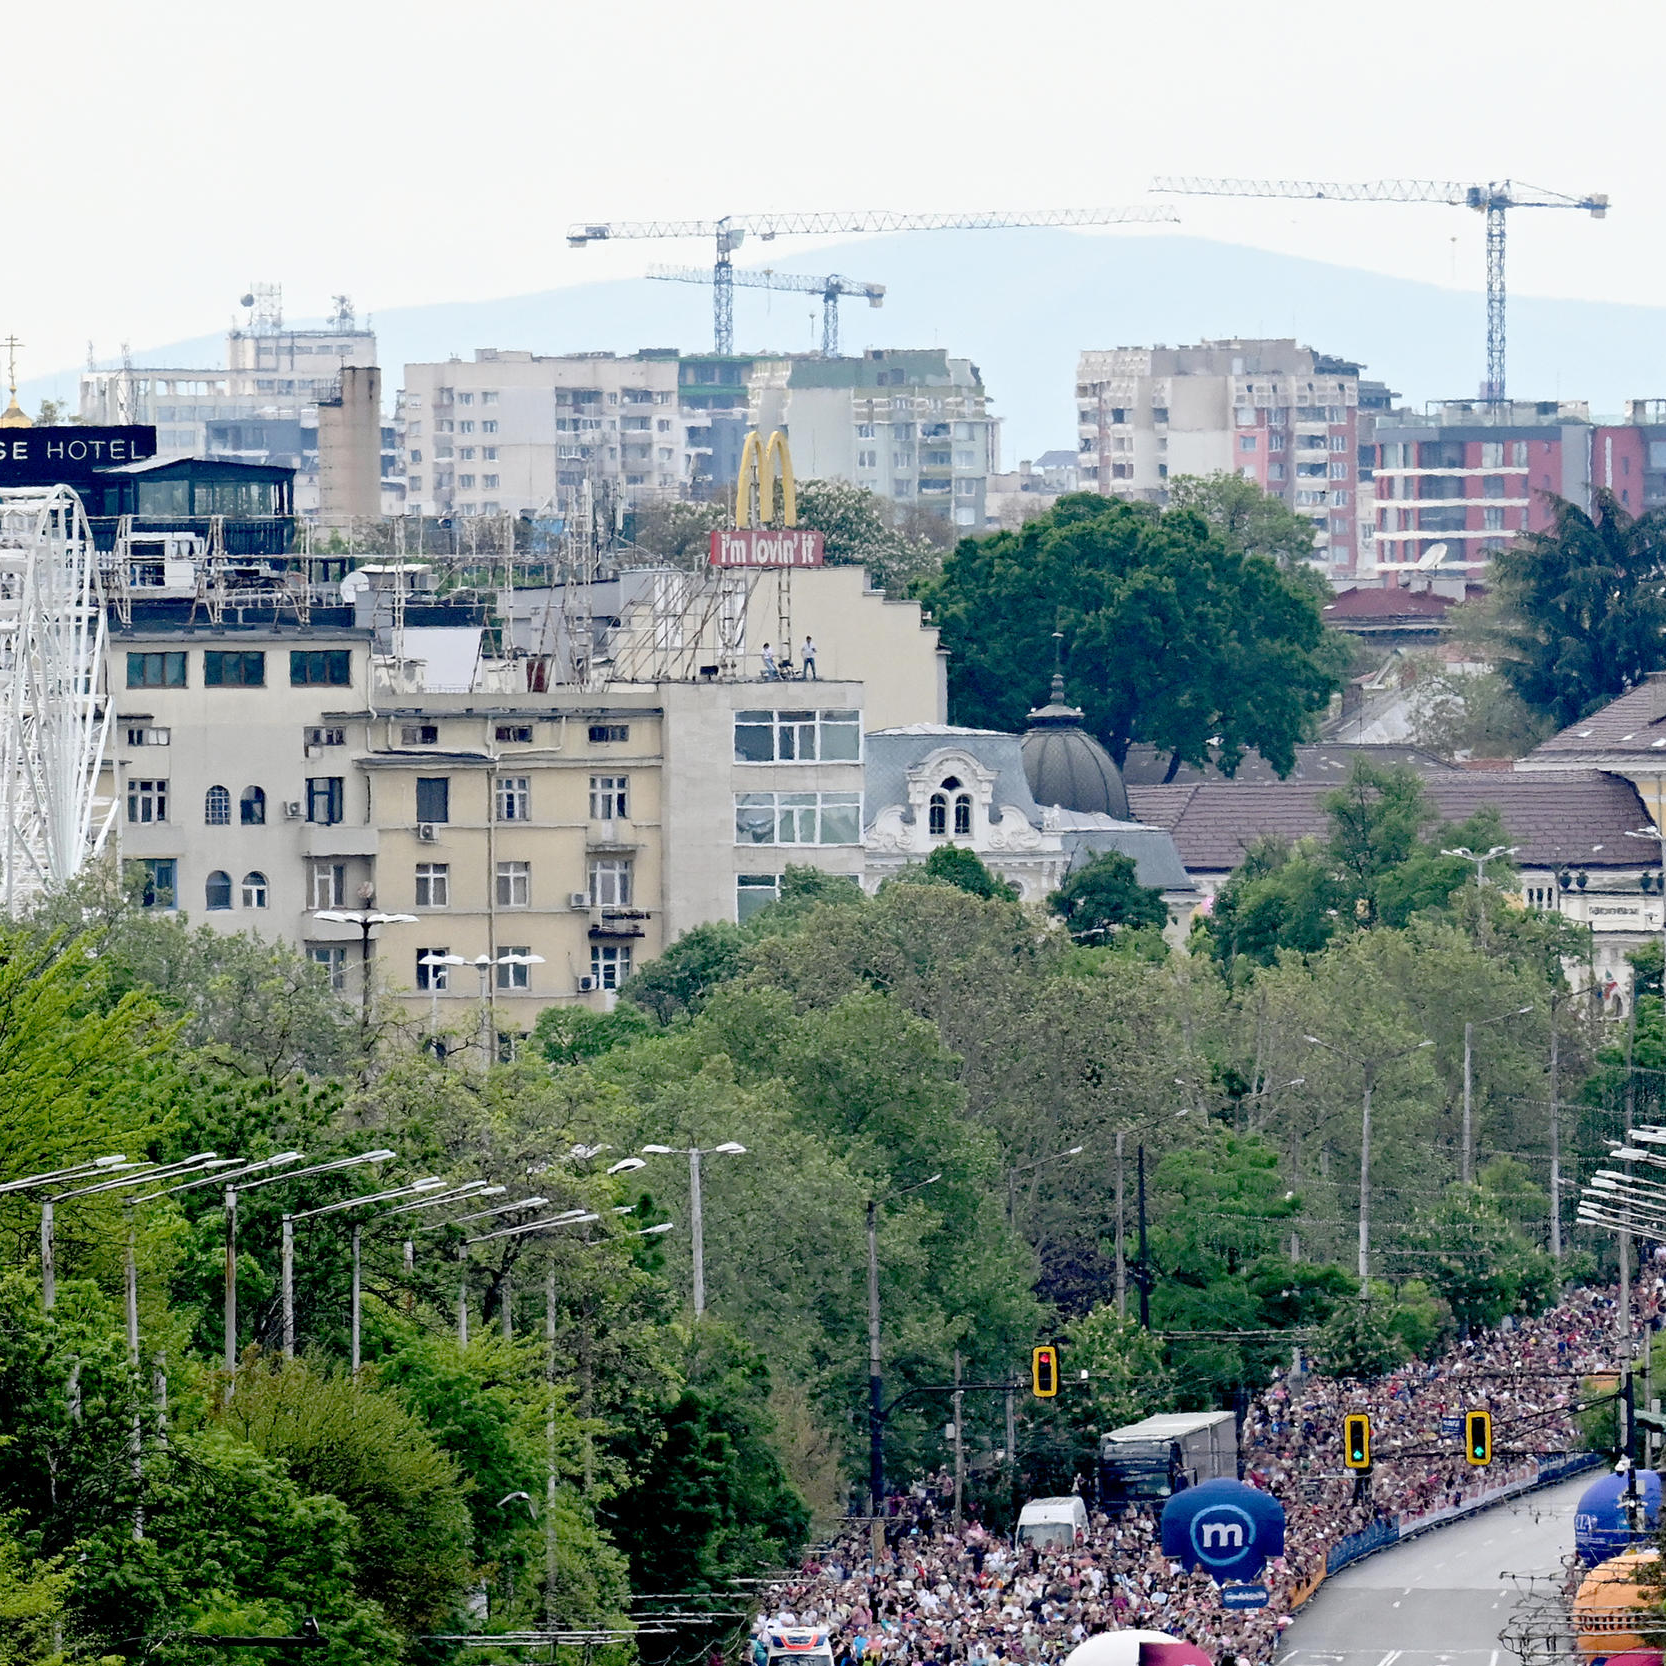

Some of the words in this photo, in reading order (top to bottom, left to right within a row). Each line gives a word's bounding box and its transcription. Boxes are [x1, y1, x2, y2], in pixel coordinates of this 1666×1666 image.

[47, 440, 146, 460] HOTEL
[720, 533, 746, 563] i'm
[752, 532, 798, 563] lovin'
[801, 532, 817, 563] it
[1202, 1522, 1243, 1547] m
